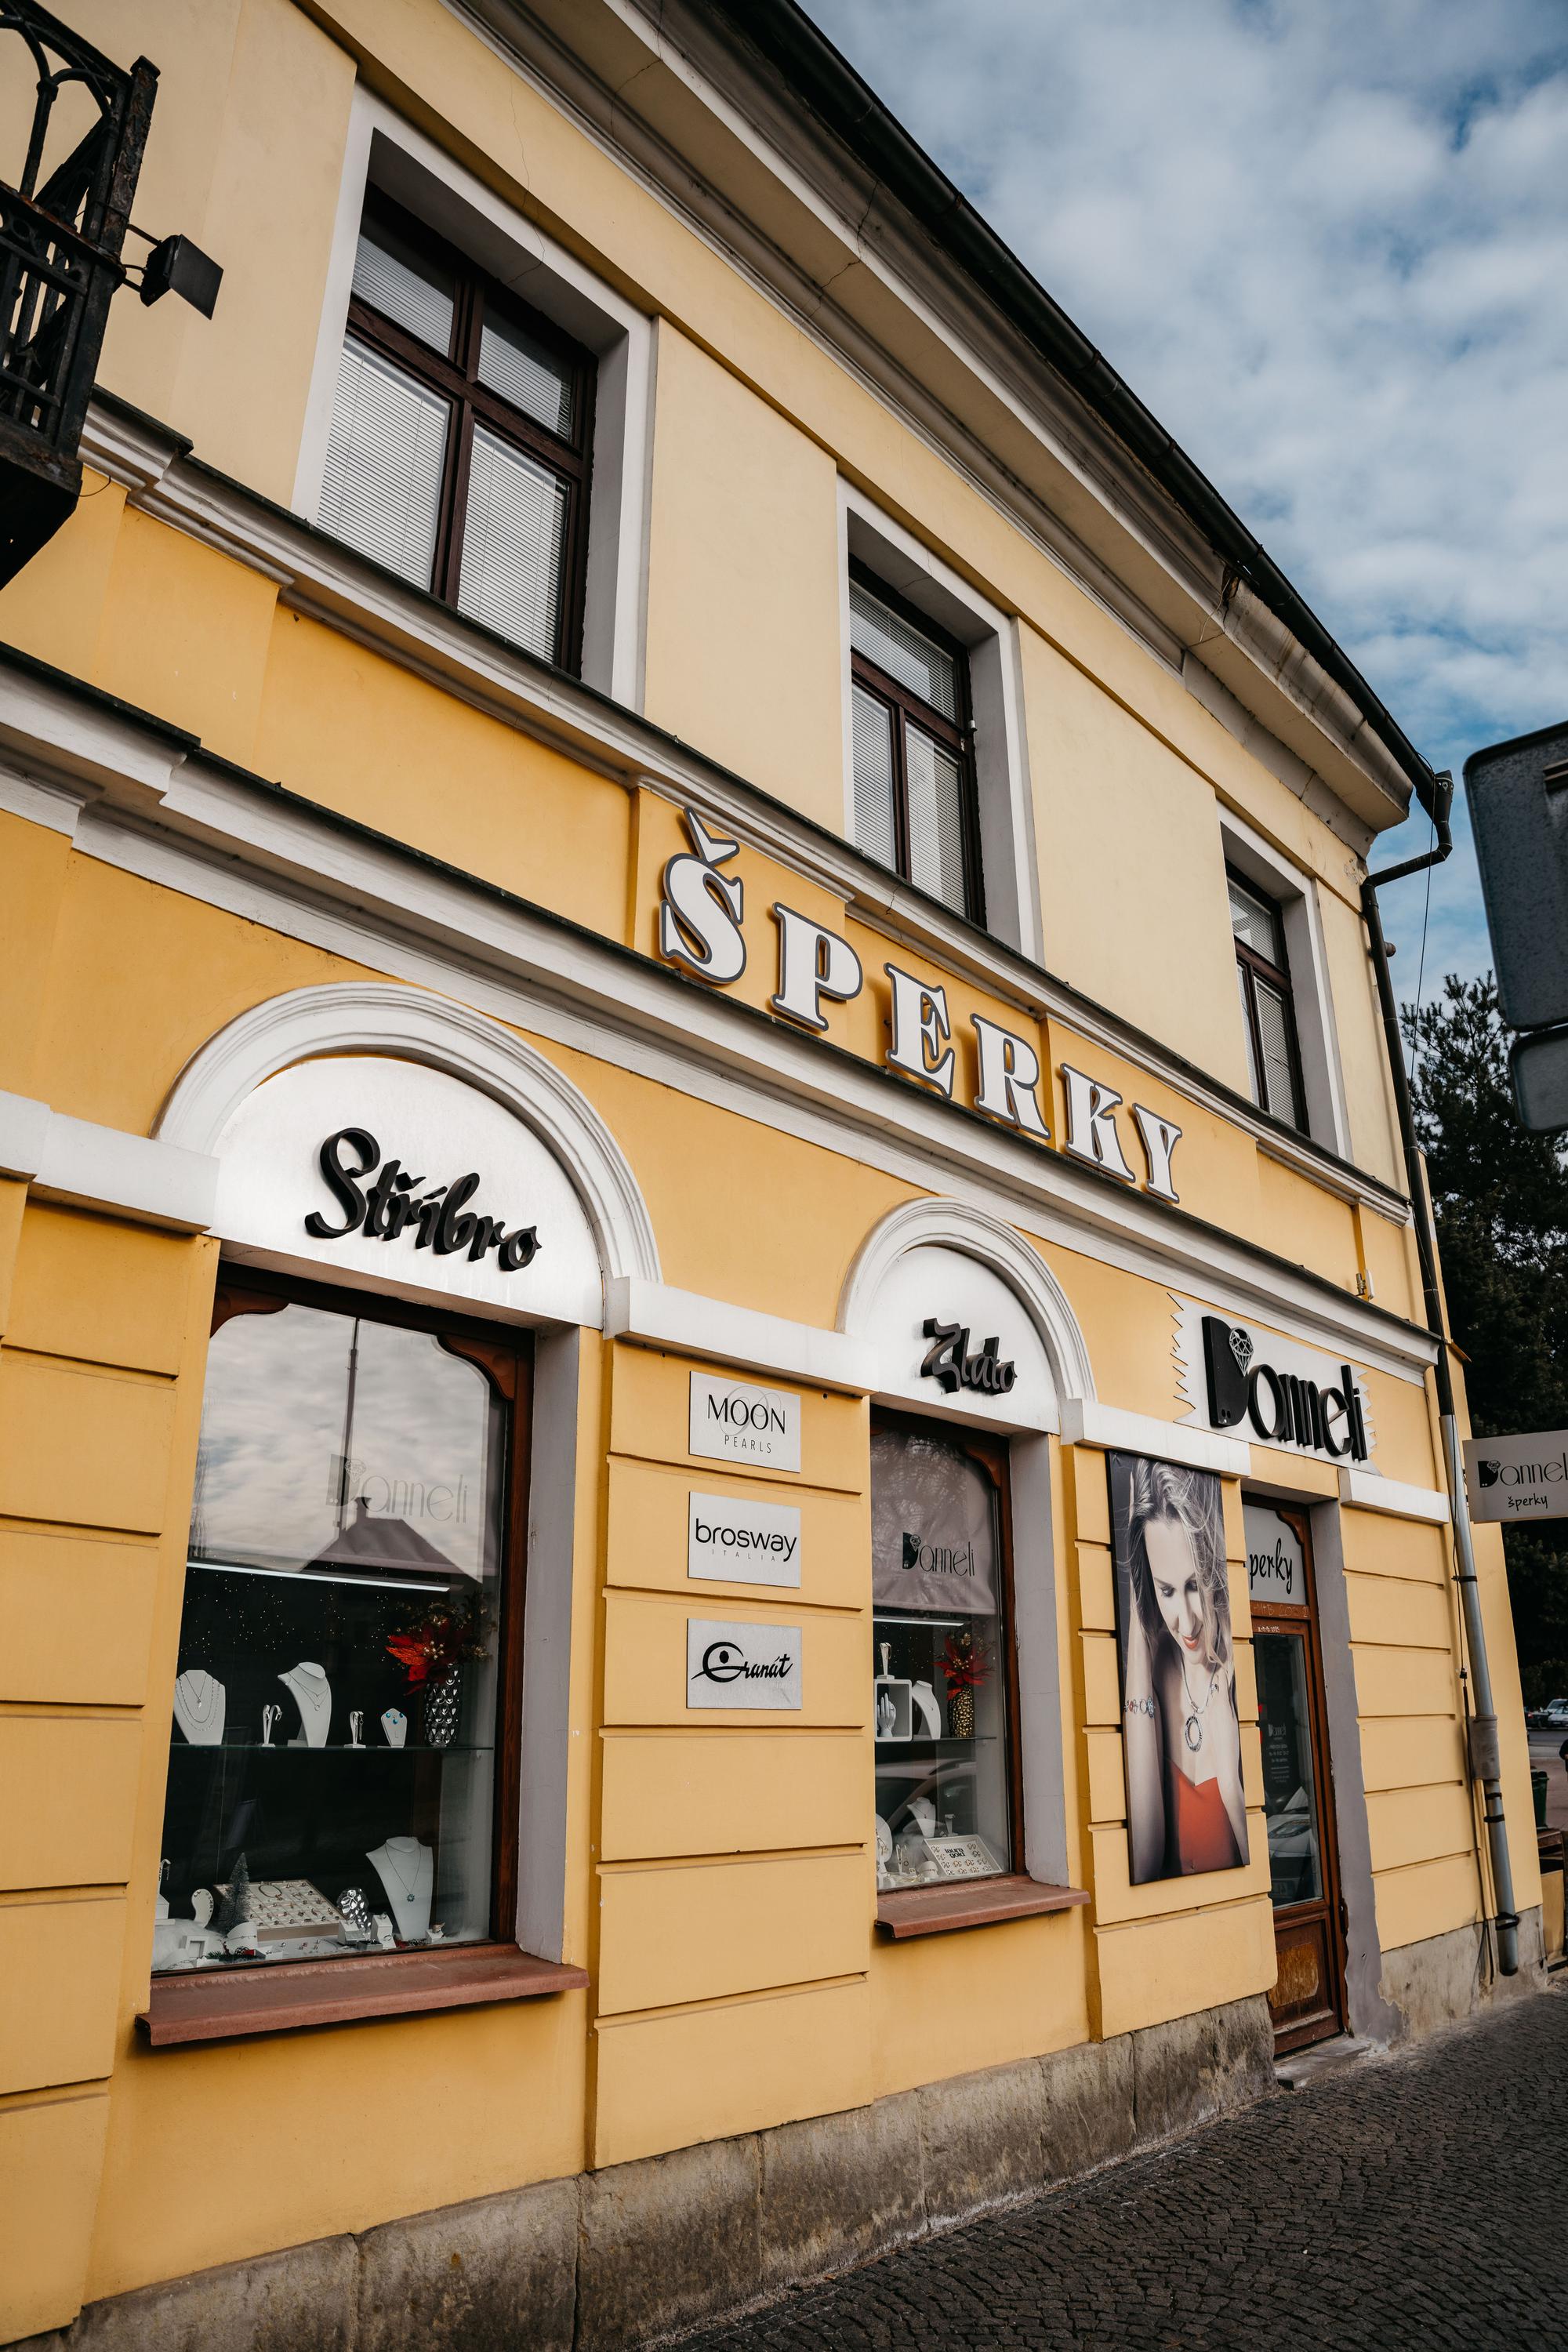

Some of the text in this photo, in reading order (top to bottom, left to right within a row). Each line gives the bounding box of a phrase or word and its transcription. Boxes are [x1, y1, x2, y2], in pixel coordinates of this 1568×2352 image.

[659, 807, 1183, 1203] ŠPERKY
[305, 1127, 543, 1272] Stříbro
[921, 1317, 1018, 1394] Zlato
[1201, 1316, 1368, 1461] Danneli
[707, 1394, 786, 1435] MOON
[724, 1436, 771, 1454] PEARLS
[326, 1454, 467, 1523] Danneli
[1478, 1452, 1568, 1488] Dannel
[1508, 1493, 1548, 1512] šperky
[695, 1518, 797, 1563] brosway
[712, 1549, 775, 1562] ITALIA
[902, 1531, 975, 1577] Danneli
[1249, 1537, 1292, 1595] perky
[691, 1642, 793, 1682] Granát
